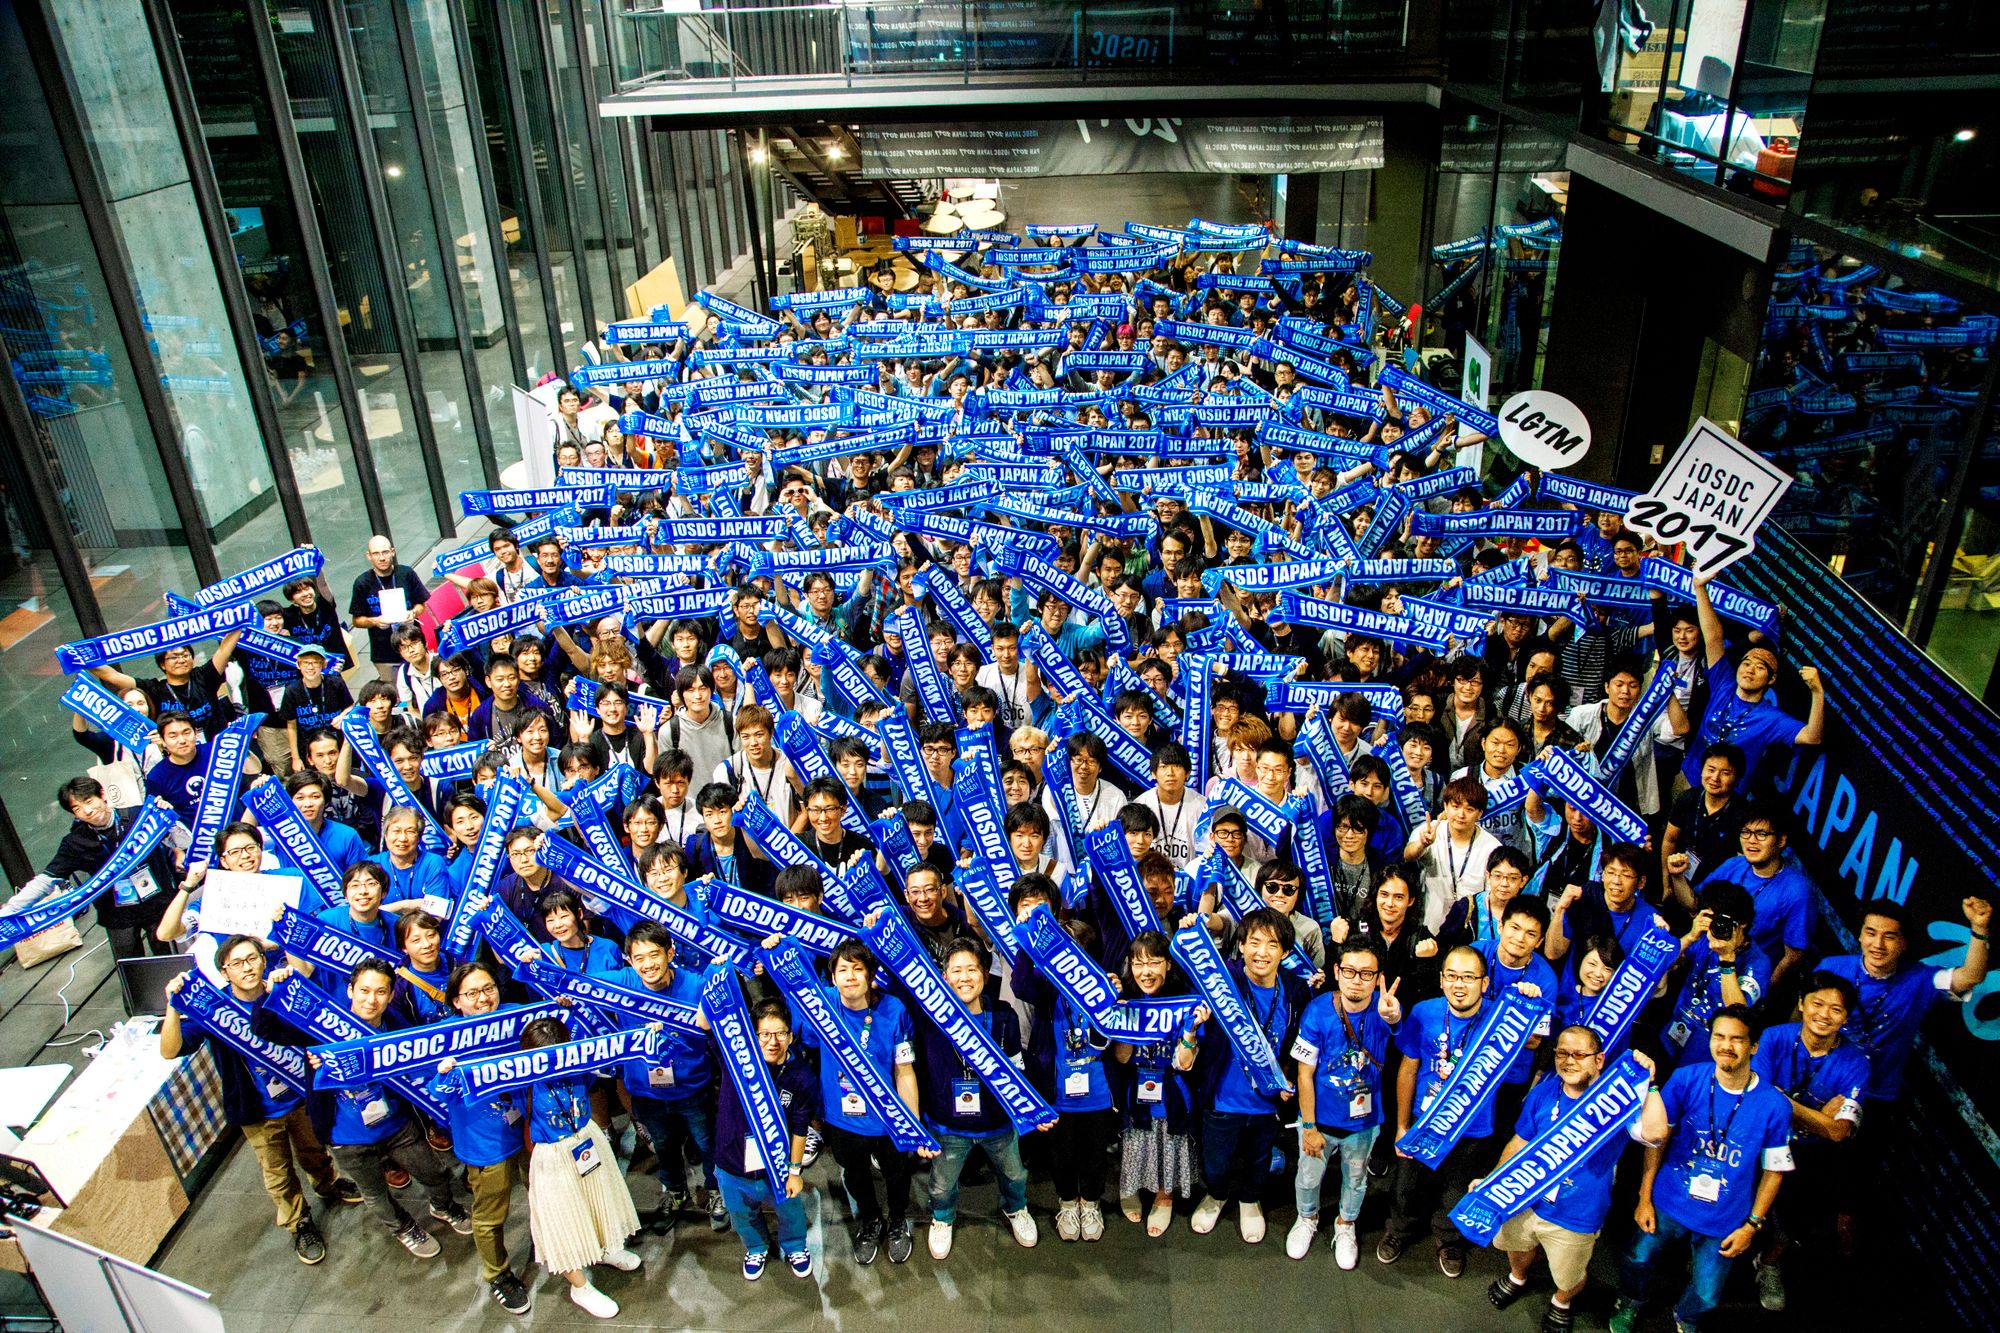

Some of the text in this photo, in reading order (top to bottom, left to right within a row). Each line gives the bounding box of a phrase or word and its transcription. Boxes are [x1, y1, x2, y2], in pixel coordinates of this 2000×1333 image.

[1006, 333, 1037, 347] JAPAN
[938, 423, 970, 437] JAPAN
[1266, 427, 1295, 441] 2017
[1466, 410, 1496, 430] 2017
[1504, 402, 1584, 455] LGTM
[1298, 432, 1335, 449] JAPAN
[948, 484, 989, 502] JAPAN
[1688, 458, 1754, 502] iOSDC
[534, 490, 573, 504] JAPAN
[1587, 489, 1629, 510] JAPAN
[1673, 482, 1744, 527] JAPAN
[719, 519, 766, 536] JAPAN
[1491, 515, 1533, 530] JAPAN
[1536, 516, 1570, 530] 2017
[1630, 501, 1748, 572] 2017
[824, 546, 871, 561] JAPAN
[1018, 532, 1052, 552] 2017
[242, 562, 284, 590] JAPAN
[285, 551, 314, 572] 2017
[658, 556, 701, 572] JAPAN
[1273, 562, 1320, 583] JAPAN
[1365, 560, 1408, 575] JAPAN
[1648, 562, 1680, 586] 2017
[1065, 579, 1110, 615] JAPAN
[1102, 612, 1126, 645] 2017
[1520, 590, 1568, 607] JAPAN
[162, 618, 210, 642] JAPAN
[214, 604, 250, 628] 2017
[960, 606, 992, 645] JAPAN
[1356, 611, 1410, 634] JAPAN
[912, 661, 940, 701] JAPAN
[349, 725, 379, 766] 2017
[446, 751, 478, 772] 2017
[201, 781, 231, 822] JAPAN
[1590, 794, 1642, 840] JAPAN
[127, 816, 160, 852] 2017
[475, 834, 504, 889] JAPAN
[491, 785, 519, 829] 2017
[1094, 830, 1119, 850] 2017
[817, 870, 855, 918] JAPAN
[966, 875, 1001, 928] 2017
[283, 912, 297, 944] 2017
[482, 905, 504, 934] 2017
[641, 896, 701, 941] JAPAN
[1027, 916, 1047, 948] 2017
[876, 919, 896, 949] 2017
[1642, 929, 1675, 952] 2017
[771, 948, 799, 970] 2017
[284, 978, 300, 1011] 2017
[450, 1019, 516, 1050] JAPAN
[318, 1050, 344, 1081] 2017
[556, 1035, 625, 1069] JAPAN
[1471, 1045, 1504, 1095] JAPAN
[1494, 1006, 1529, 1051] 2017
[949, 1021, 997, 1074] JAPAN
[994, 1071, 1035, 1112] 2017
[1536, 1116, 1598, 1171] JAPAN
[1585, 1076, 1637, 1125] 2017
[1403, 1145, 1436, 1159] 2017
[1456, 1214, 1491, 1233] 2017
